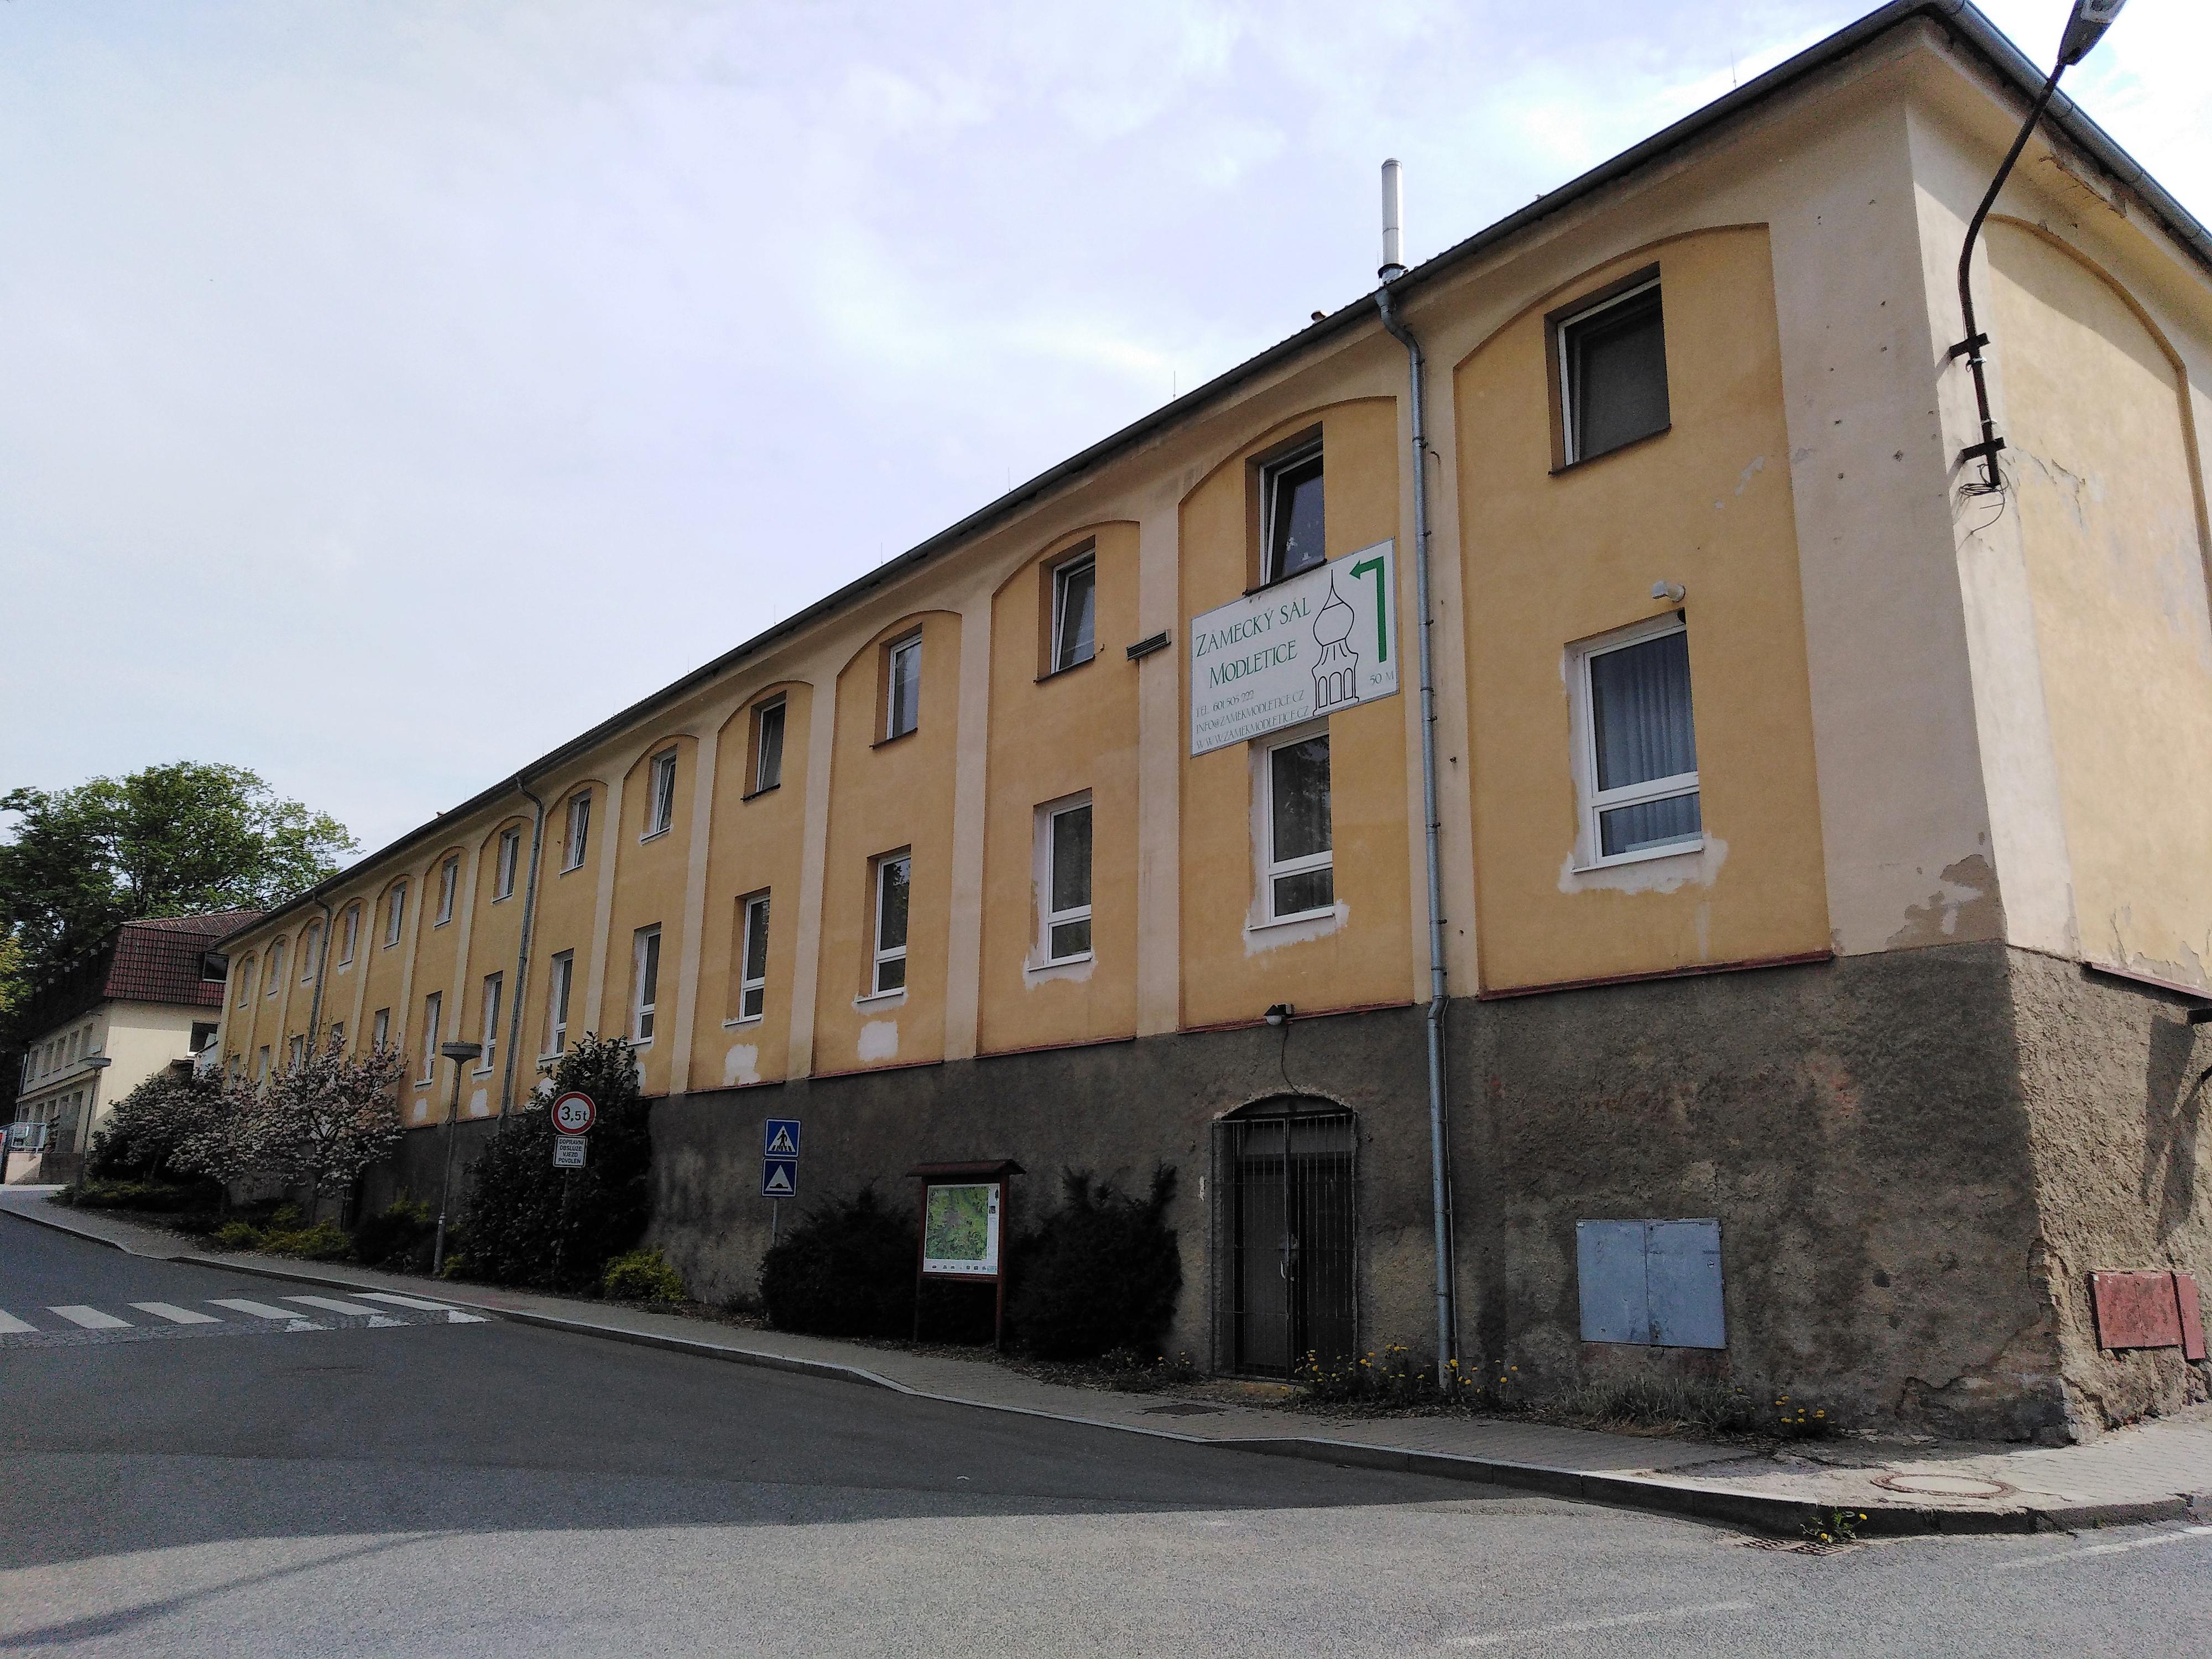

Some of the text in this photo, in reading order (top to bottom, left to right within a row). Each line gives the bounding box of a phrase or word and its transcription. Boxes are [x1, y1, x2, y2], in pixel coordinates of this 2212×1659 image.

[1280, 597, 1311, 625] SÁL
[1209, 639, 1298, 688] MODLETICE
[1370, 670, 1394, 686] 50 M
[1213, 700, 1224, 712] 601
[1240, 690, 1254, 702] 222
